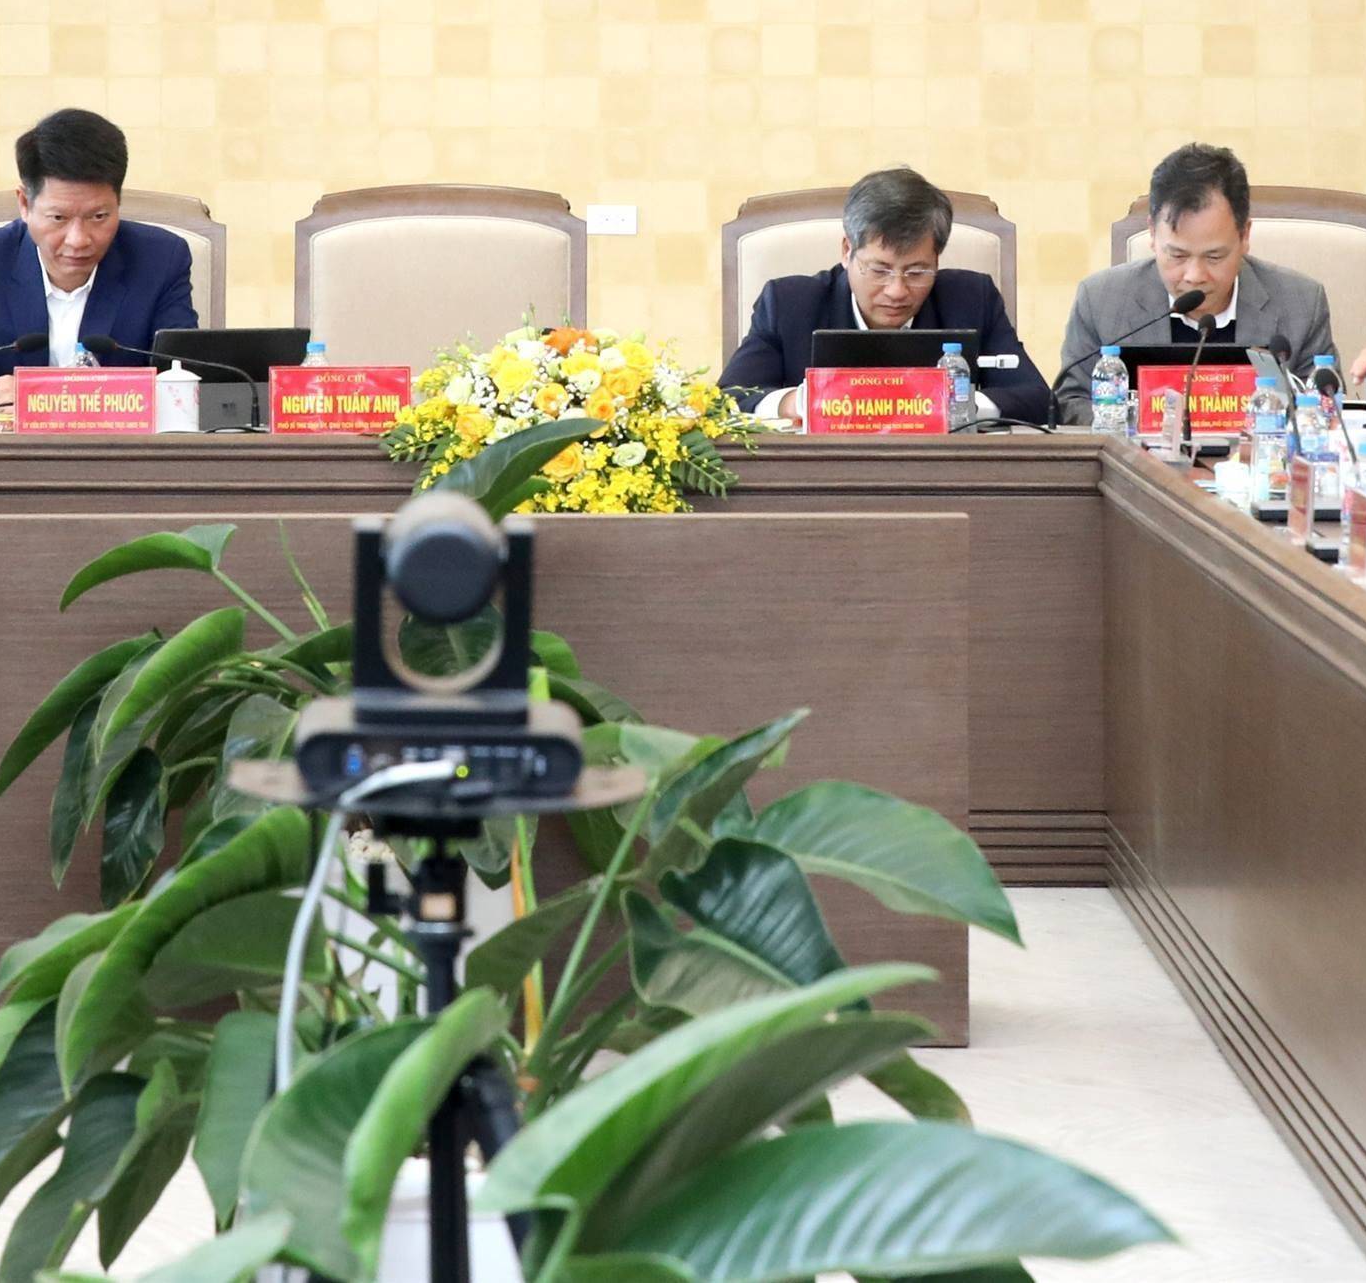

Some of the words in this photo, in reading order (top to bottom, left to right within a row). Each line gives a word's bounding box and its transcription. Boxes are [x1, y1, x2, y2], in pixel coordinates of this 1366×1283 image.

[27, 384, 76, 413] NGUYỄN
[78, 386, 102, 413] THẾ
[104, 389, 144, 413] PHƯỚC
[336, 386, 370, 414] TUẤN
[373, 395, 400, 414] ANH
[822, 393, 852, 417] NGÔ
[856, 399, 893, 421] HẠNH
[897, 393, 933, 416] PHÚC
[1200, 390, 1238, 414] THÀNH
